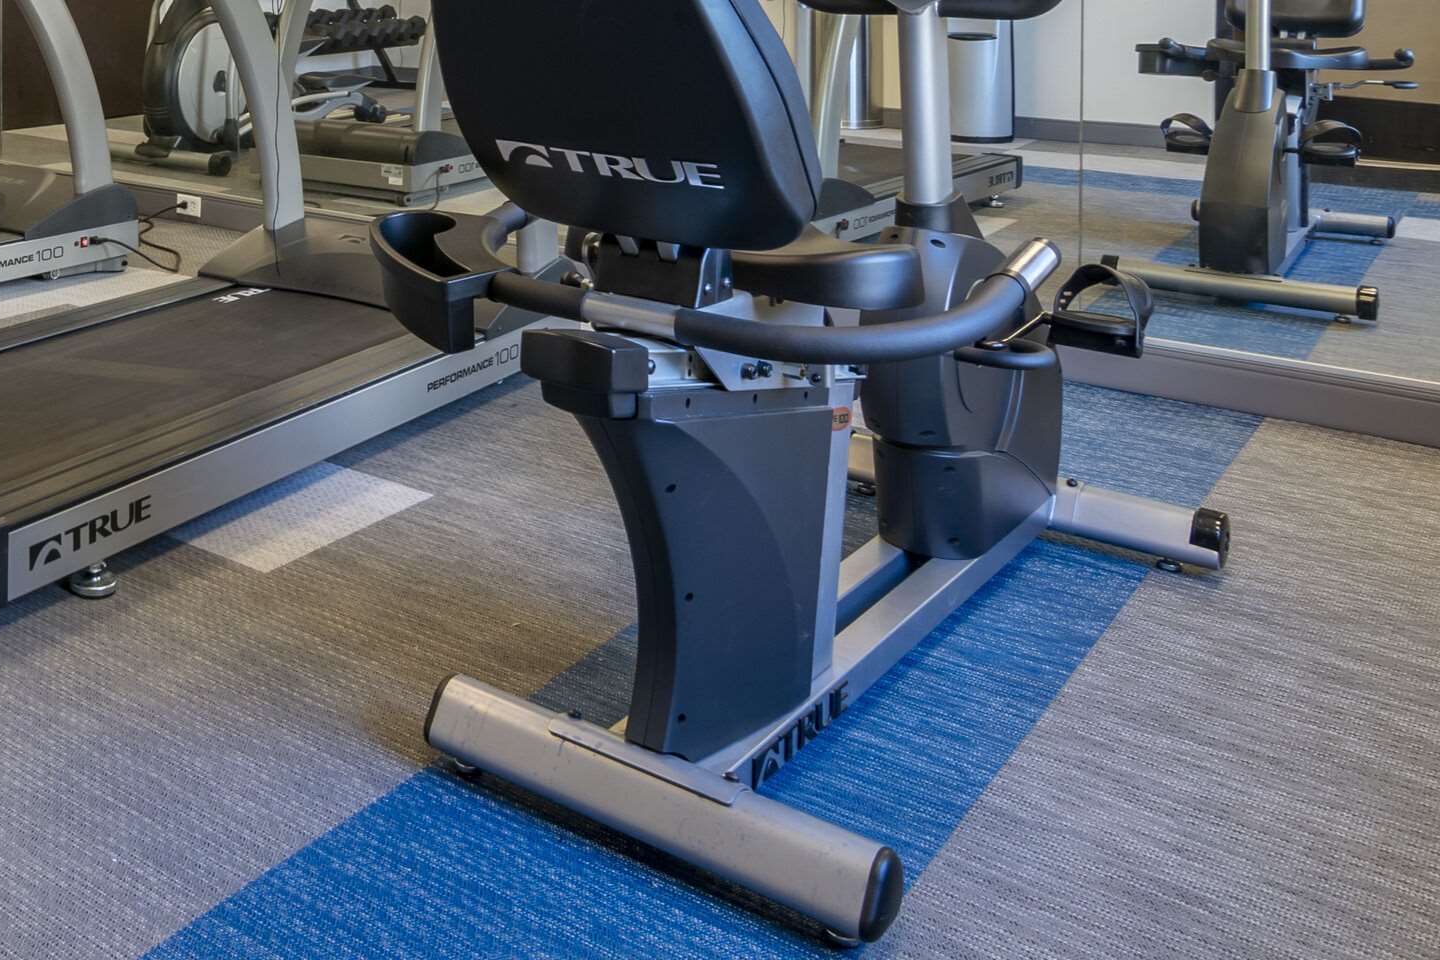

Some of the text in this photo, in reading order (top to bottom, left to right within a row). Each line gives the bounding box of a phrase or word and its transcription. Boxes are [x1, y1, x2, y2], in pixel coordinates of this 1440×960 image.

[549, 146, 725, 190] TRUE
[36, 246, 64, 262] 100
[426, 344, 519, 393] PERFORMANCE 100
[64, 495, 152, 553] TRUE
[778, 680, 848, 763] TRUE
